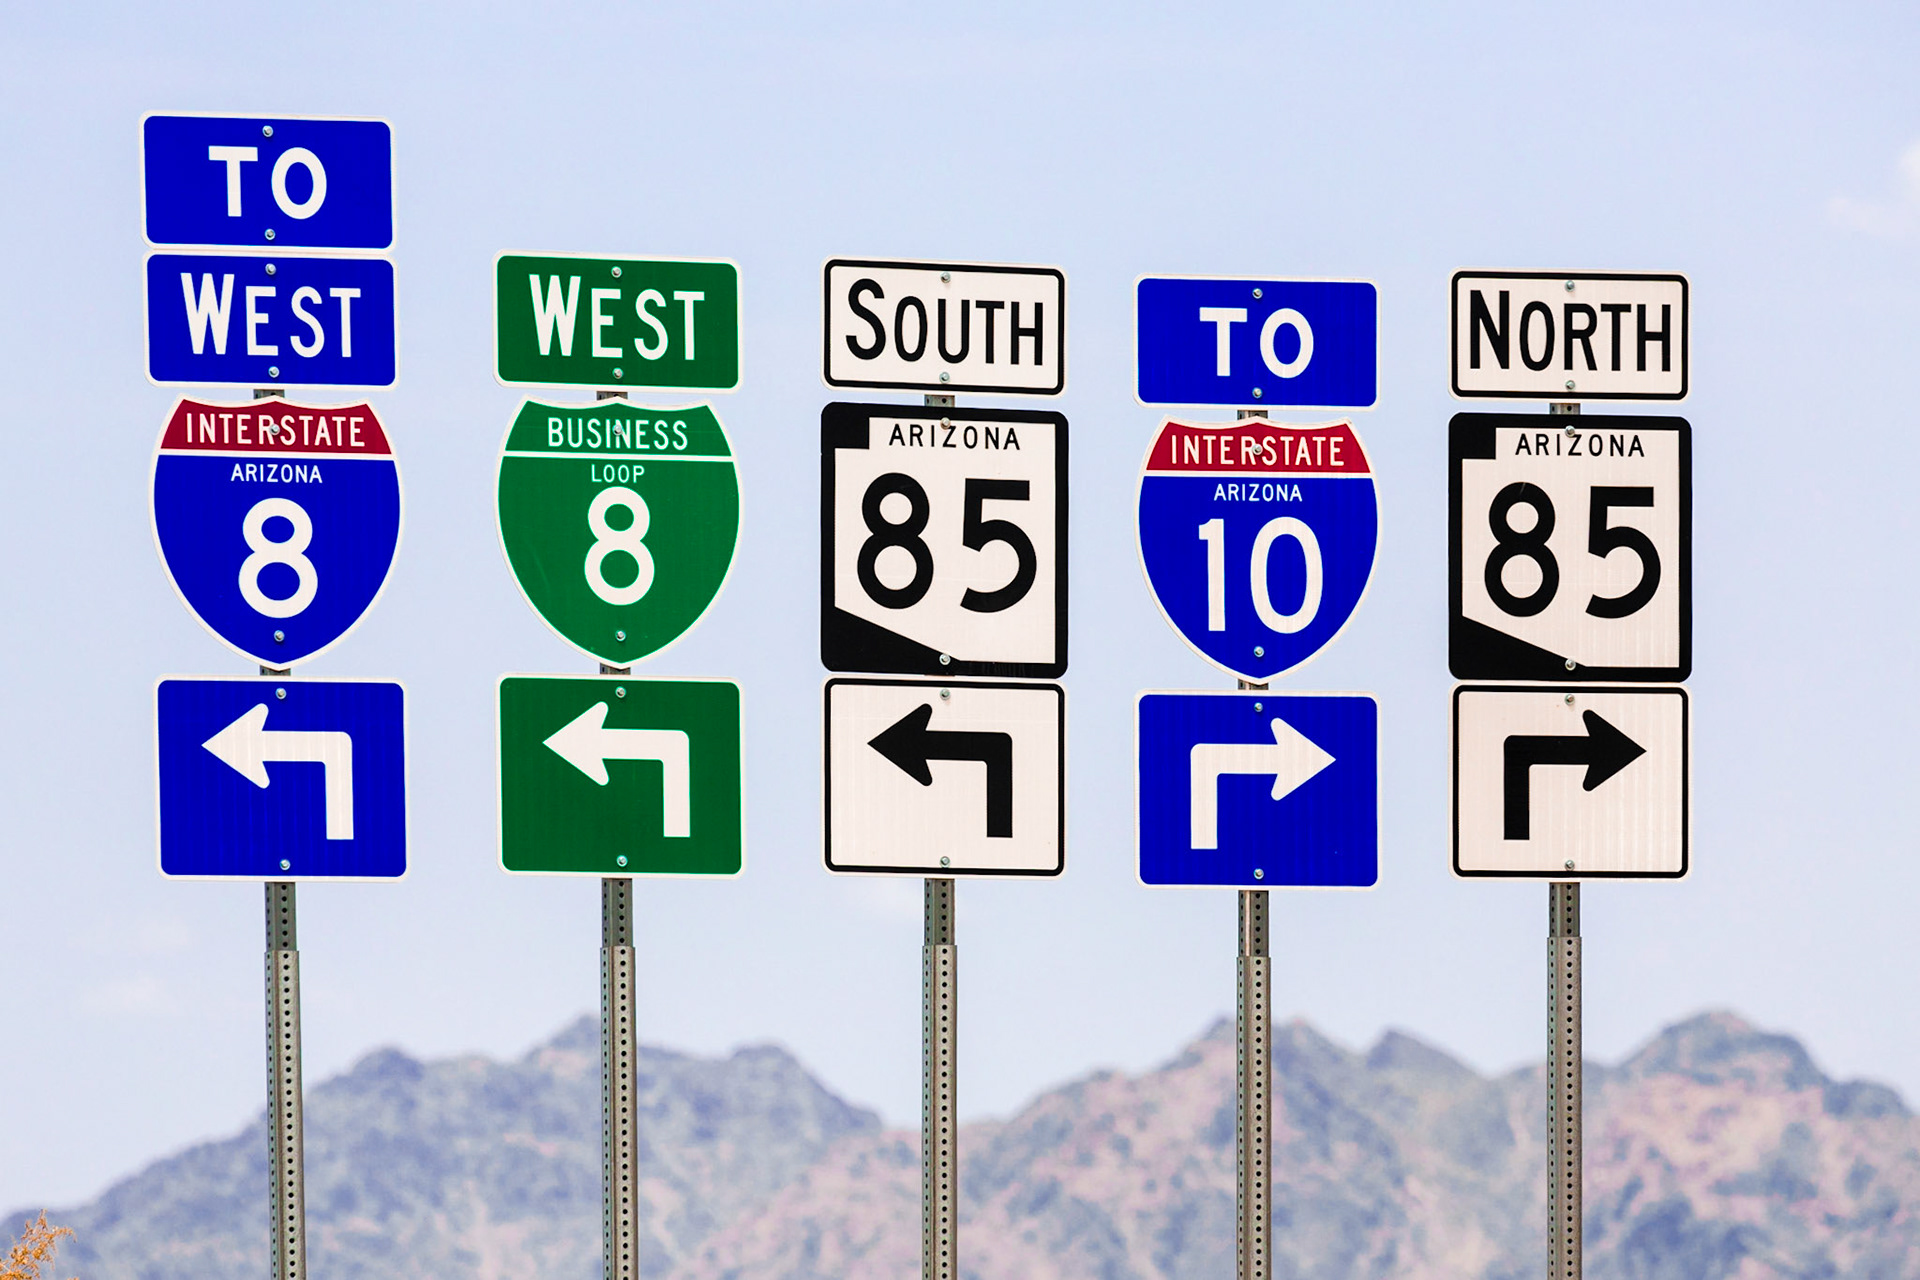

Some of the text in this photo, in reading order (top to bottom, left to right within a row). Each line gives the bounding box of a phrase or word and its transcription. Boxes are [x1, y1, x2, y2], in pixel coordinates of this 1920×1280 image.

[209, 146, 326, 219] TO
[181, 272, 361, 357] WEST
[529, 274, 704, 360] WEST
[846, 277, 1043, 365] SOUTH
[1200, 307, 1313, 378] TO
[1470, 289, 1671, 371] NORTH
[186, 412, 365, 447] INTERSTATE
[548, 418, 688, 450] BUSINESS
[889, 424, 1020, 451] ARIZONA
[1171, 434, 1344, 467] INTERSTATE
[1515, 433, 1645, 457] ARIZONA
[231, 463, 323, 484] ARIZONA
[591, 464, 645, 483] LOOP
[1213, 483, 1303, 502] ARIZONA
[238, 498, 318, 618] 8
[585, 486, 655, 606] 8
[856, 473, 1037, 613] 85
[1198, 516, 1323, 635] 10
[1484, 481, 1661, 619] 85
